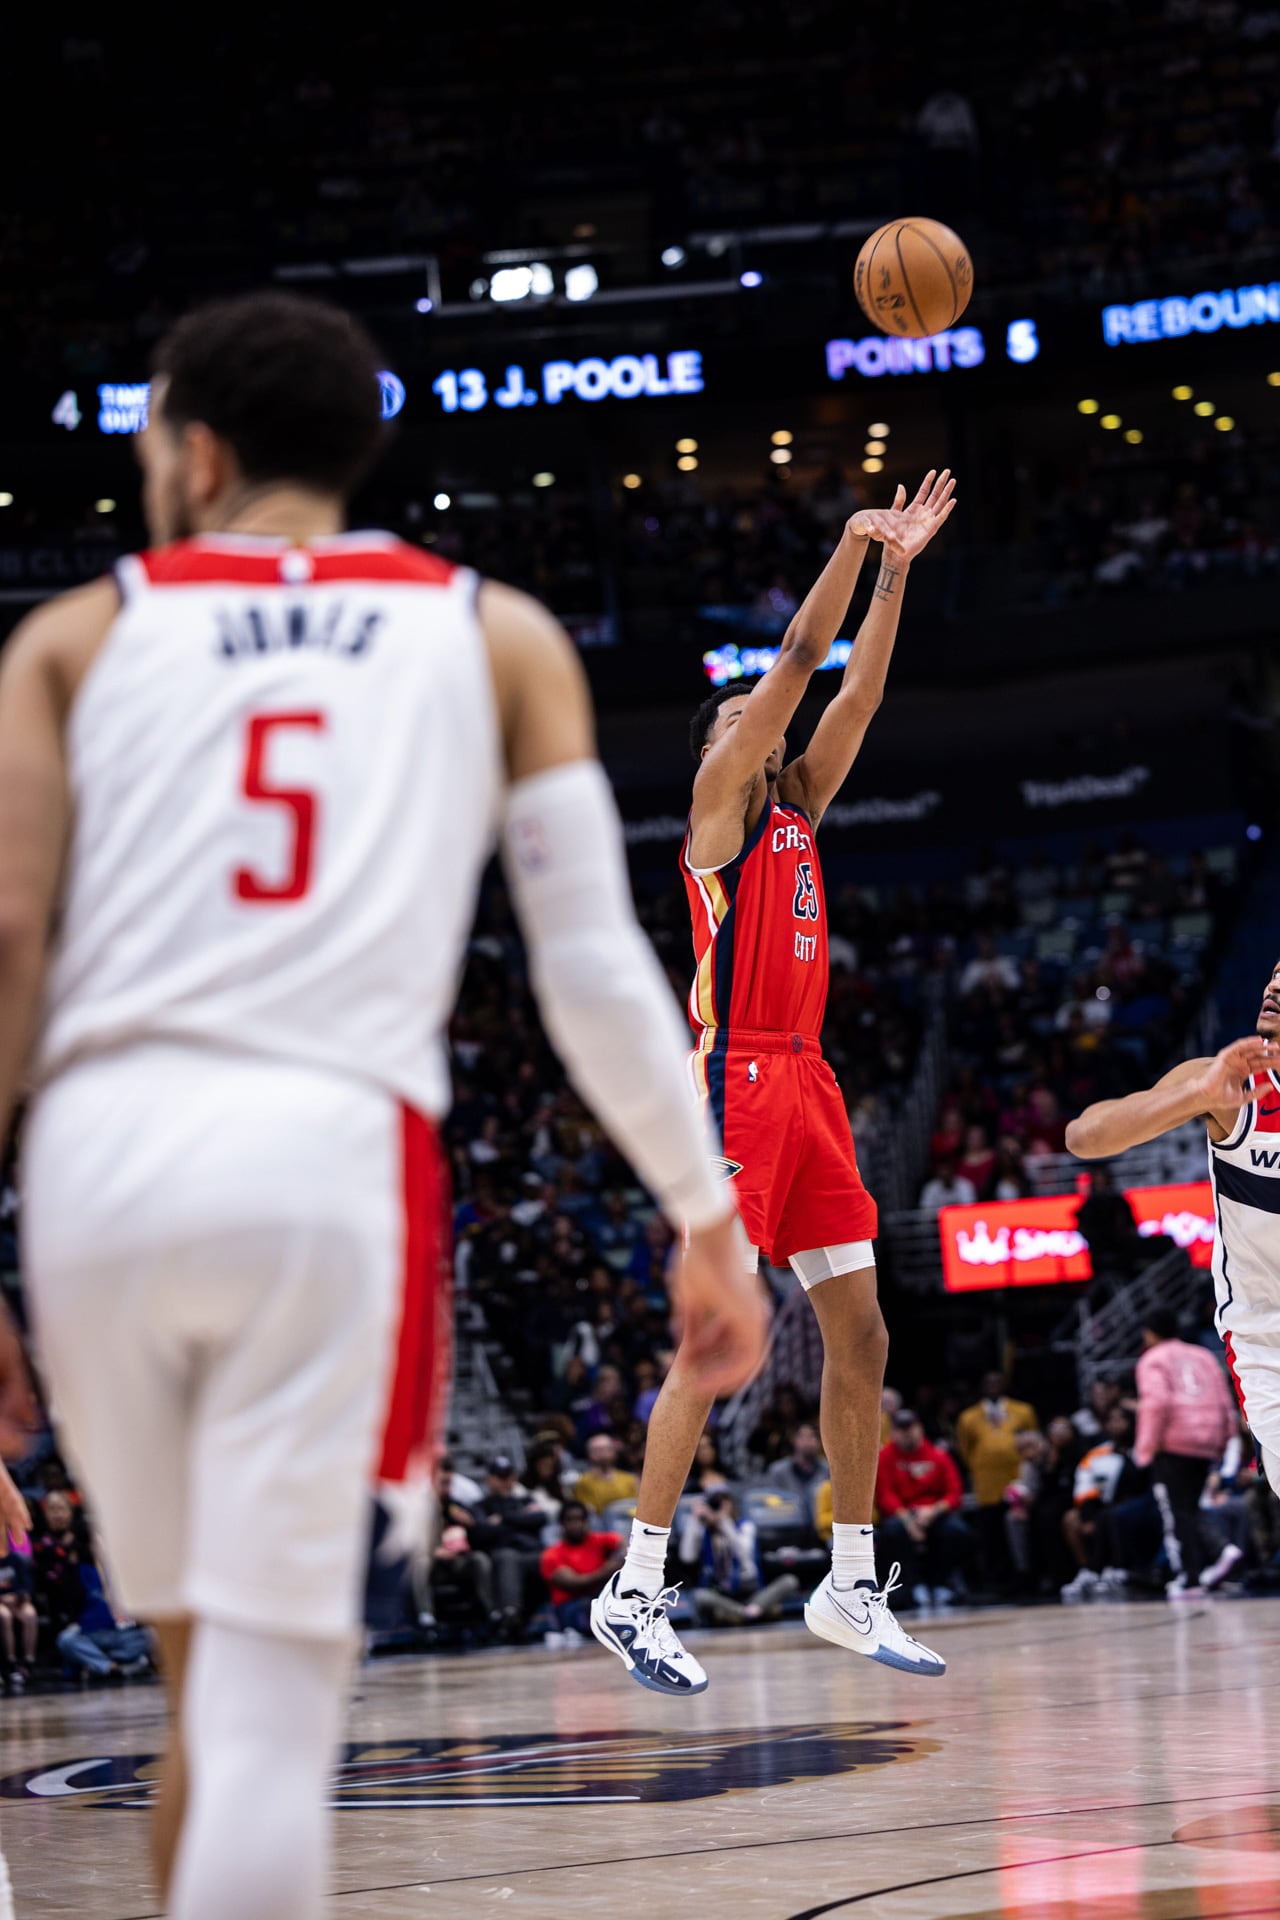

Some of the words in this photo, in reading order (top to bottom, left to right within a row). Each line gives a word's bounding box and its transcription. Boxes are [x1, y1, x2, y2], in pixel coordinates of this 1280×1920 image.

[826, 327, 985, 380] POINTS
[1006, 319, 1039, 363] 5
[52, 390, 82, 431] 4
[433, 368, 488, 412] 13
[494, 365, 538, 408] J.
[542, 351, 704, 404] POOLE
[236, 713, 326, 903] 5
[792, 862, 819, 922] 25
[794, 931, 817, 962] CITY
